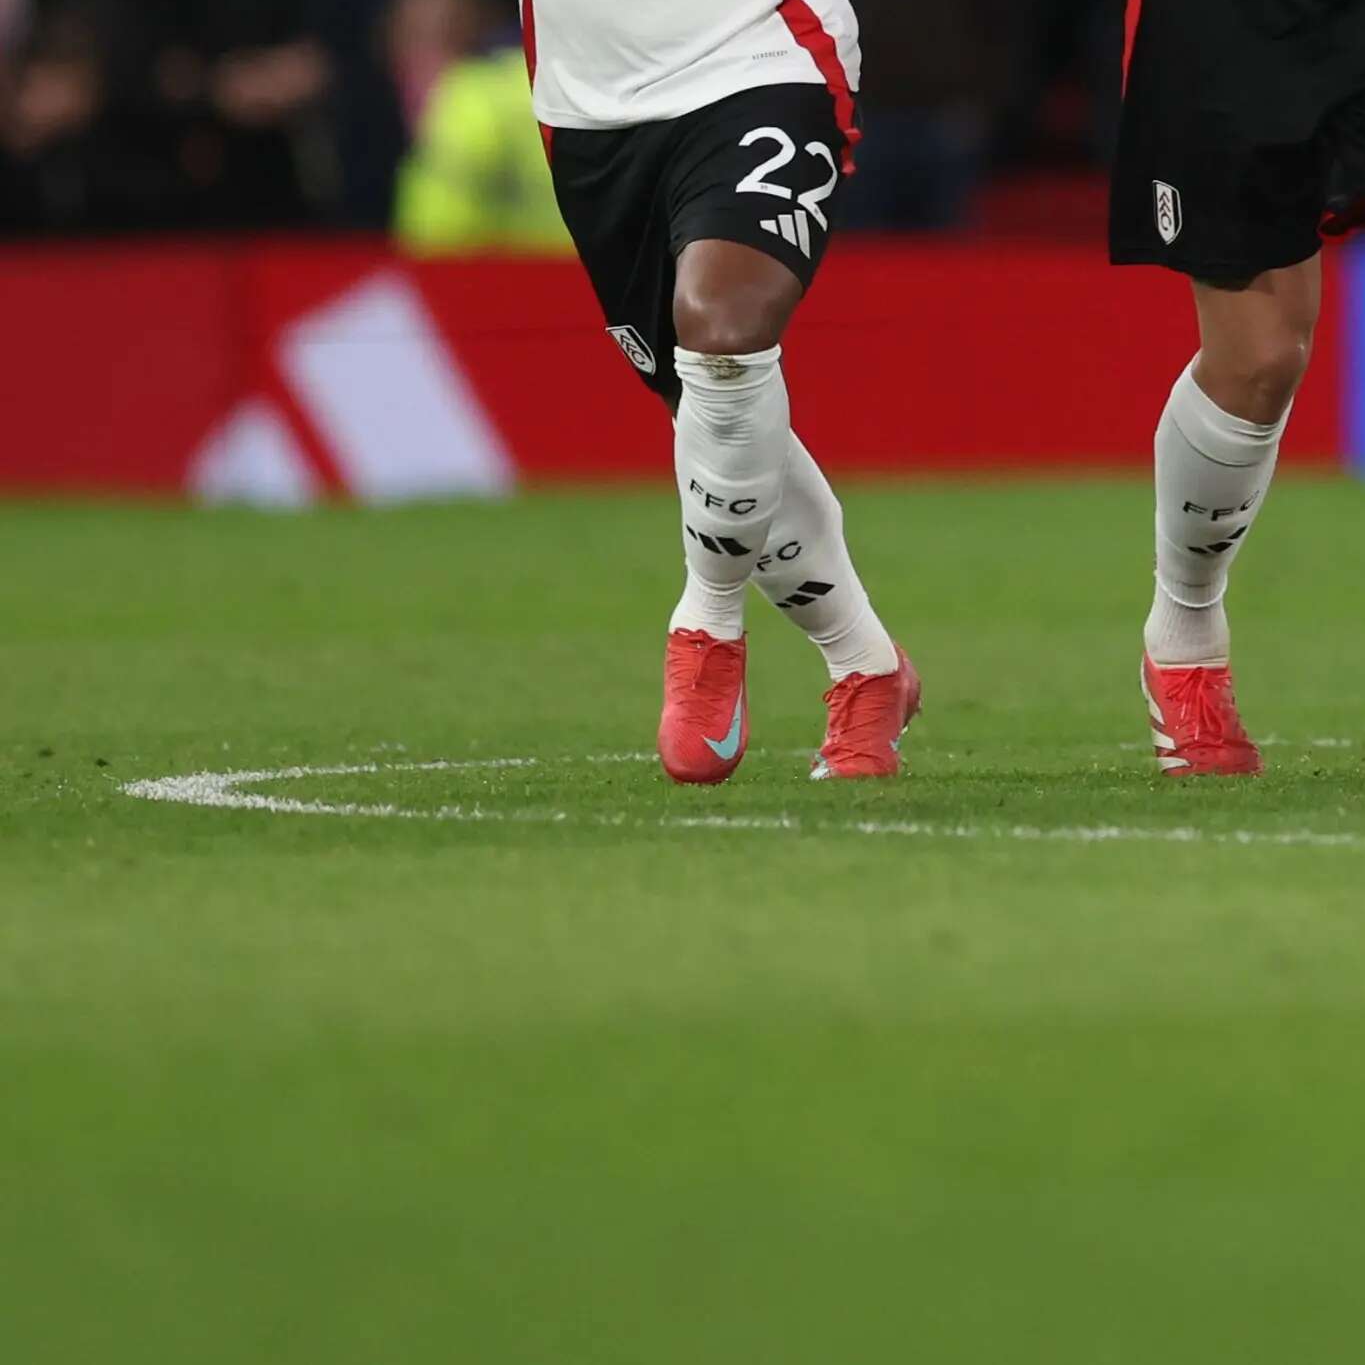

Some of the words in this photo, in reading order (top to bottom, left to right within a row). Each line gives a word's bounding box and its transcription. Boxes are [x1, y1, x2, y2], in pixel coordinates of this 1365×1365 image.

[735, 126, 838, 232] 22
[690, 478, 758, 515] FFC
[1183, 490, 1260, 522] FFC
[756, 540, 802, 572] FC
